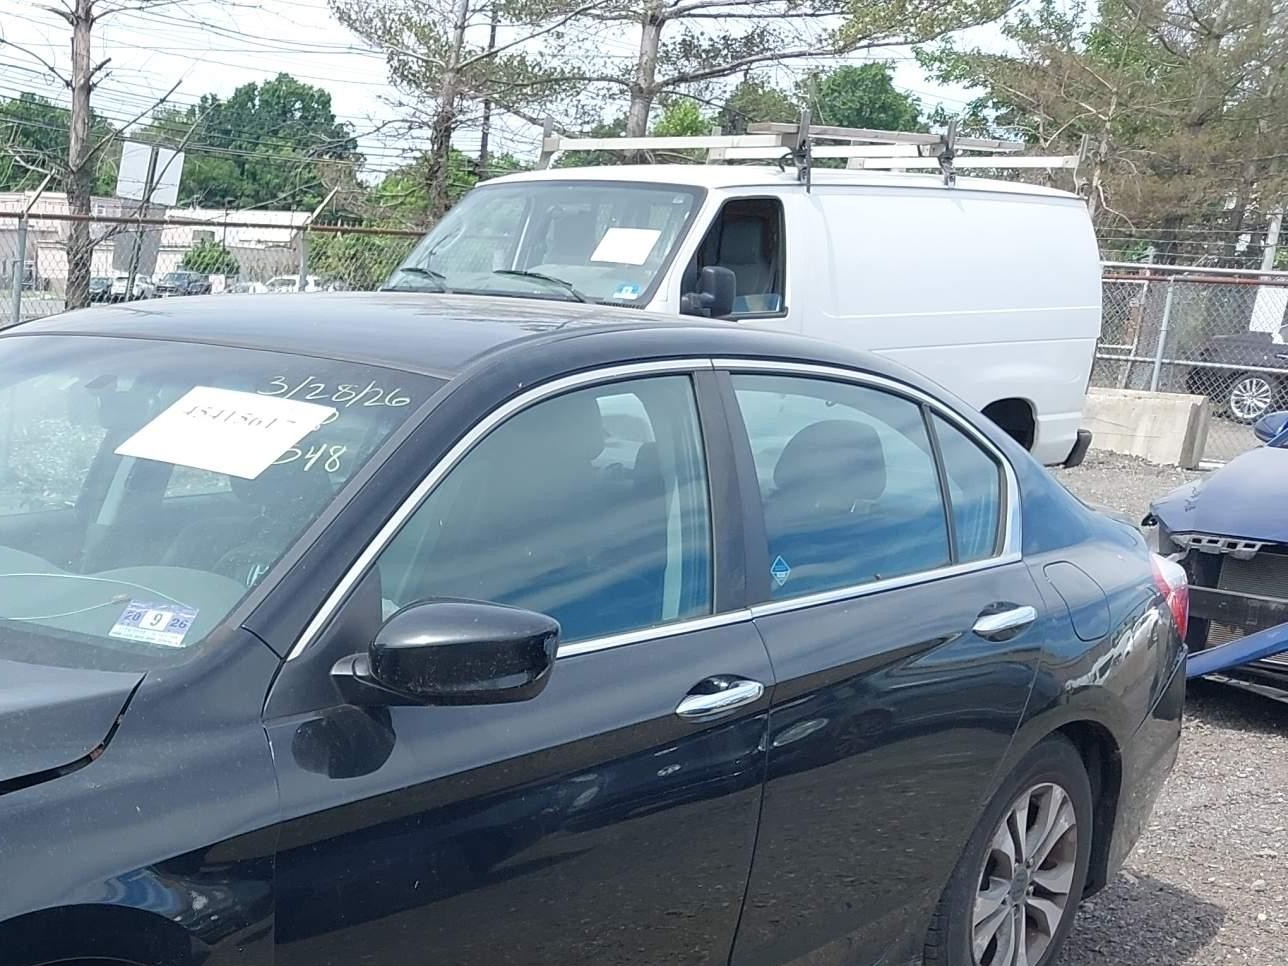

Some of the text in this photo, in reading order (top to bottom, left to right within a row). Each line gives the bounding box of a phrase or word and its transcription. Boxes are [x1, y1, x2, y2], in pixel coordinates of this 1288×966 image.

[256, 375, 411, 408] 3/28/26
[150, 612, 164, 627] 9
[169, 617, 188, 629] 26
